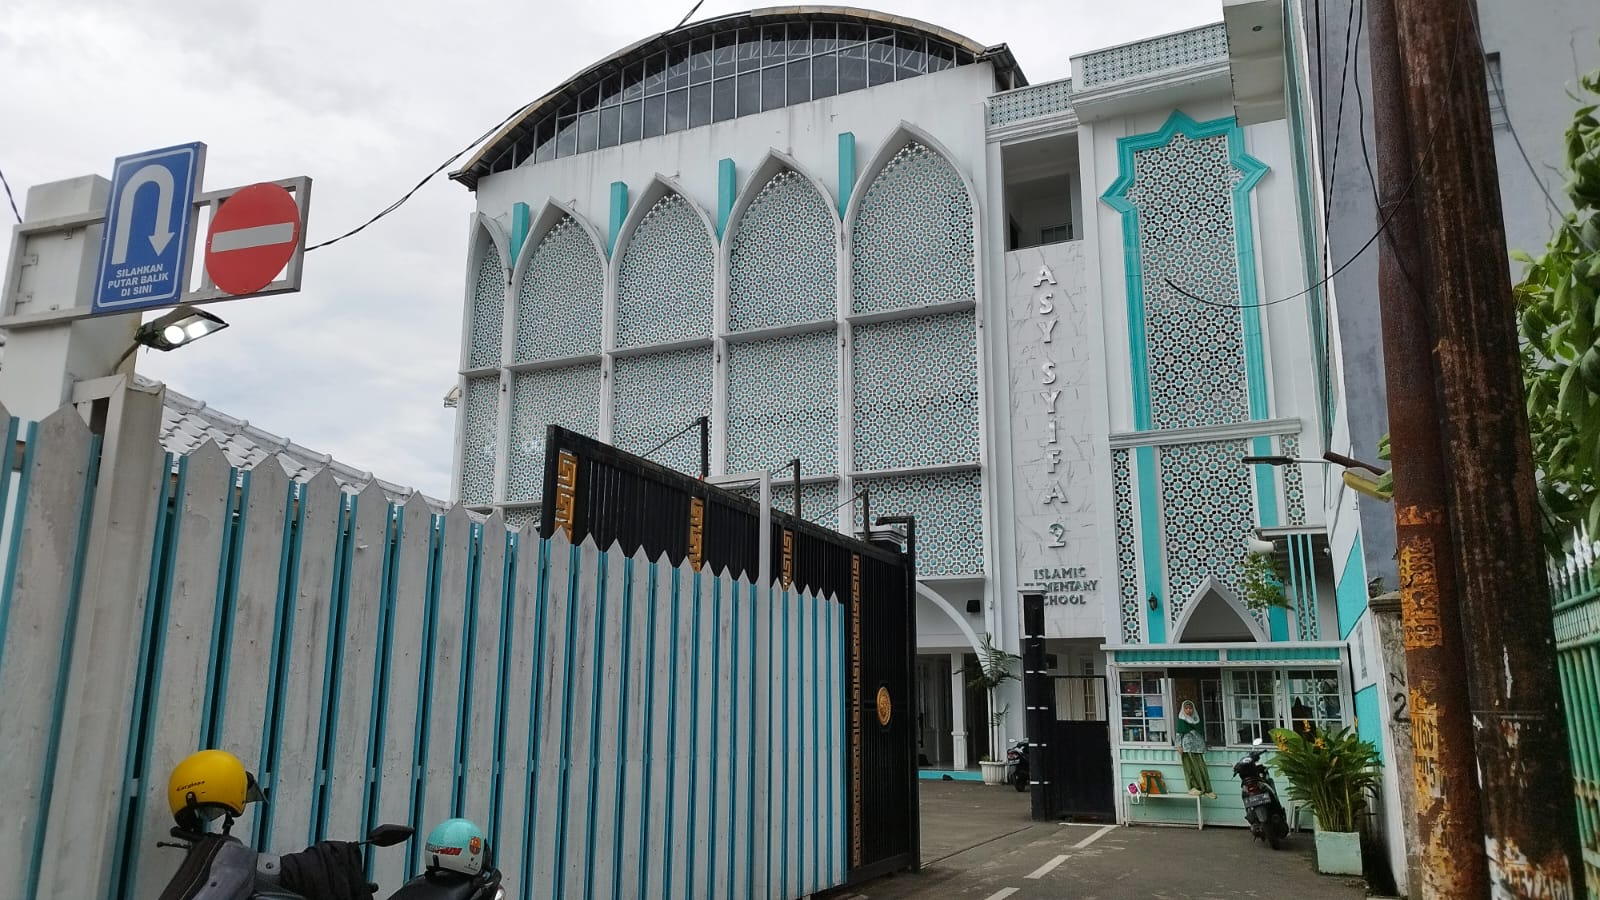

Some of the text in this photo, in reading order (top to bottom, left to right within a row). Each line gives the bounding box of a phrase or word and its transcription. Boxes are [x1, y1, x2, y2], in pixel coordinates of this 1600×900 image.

[115, 264, 164, 278] SILAHKAN
[108, 272, 169, 289] PUTAR BALIK
[121, 284, 153, 297] DI SINI
[1040, 361, 1069, 505] SYIFA
[1047, 523, 1065, 548] 2
[1033, 567, 1087, 580] ISLAMIC
[1393, 692, 1412, 724] 2
